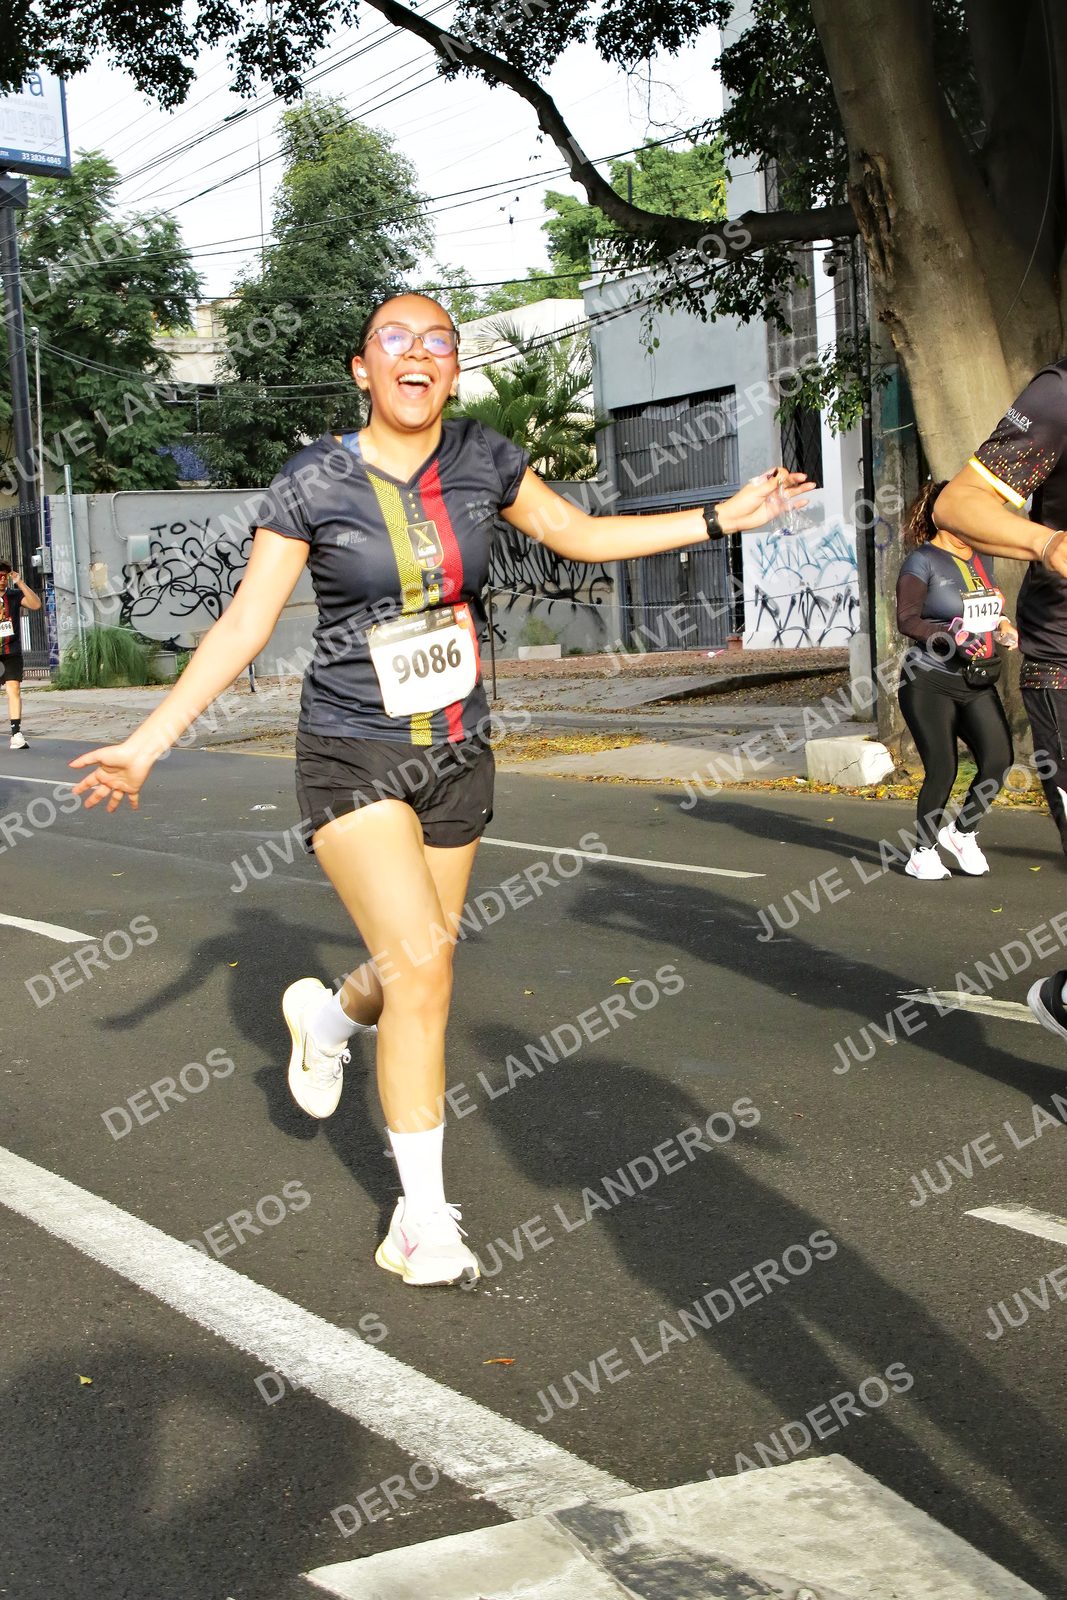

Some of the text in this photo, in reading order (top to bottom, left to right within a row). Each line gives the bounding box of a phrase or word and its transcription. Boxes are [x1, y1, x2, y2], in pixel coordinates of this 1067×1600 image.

[150, 517, 211, 542] TOY
[967, 601, 1000, 618] 11412
[392, 638, 462, 685] 9086
